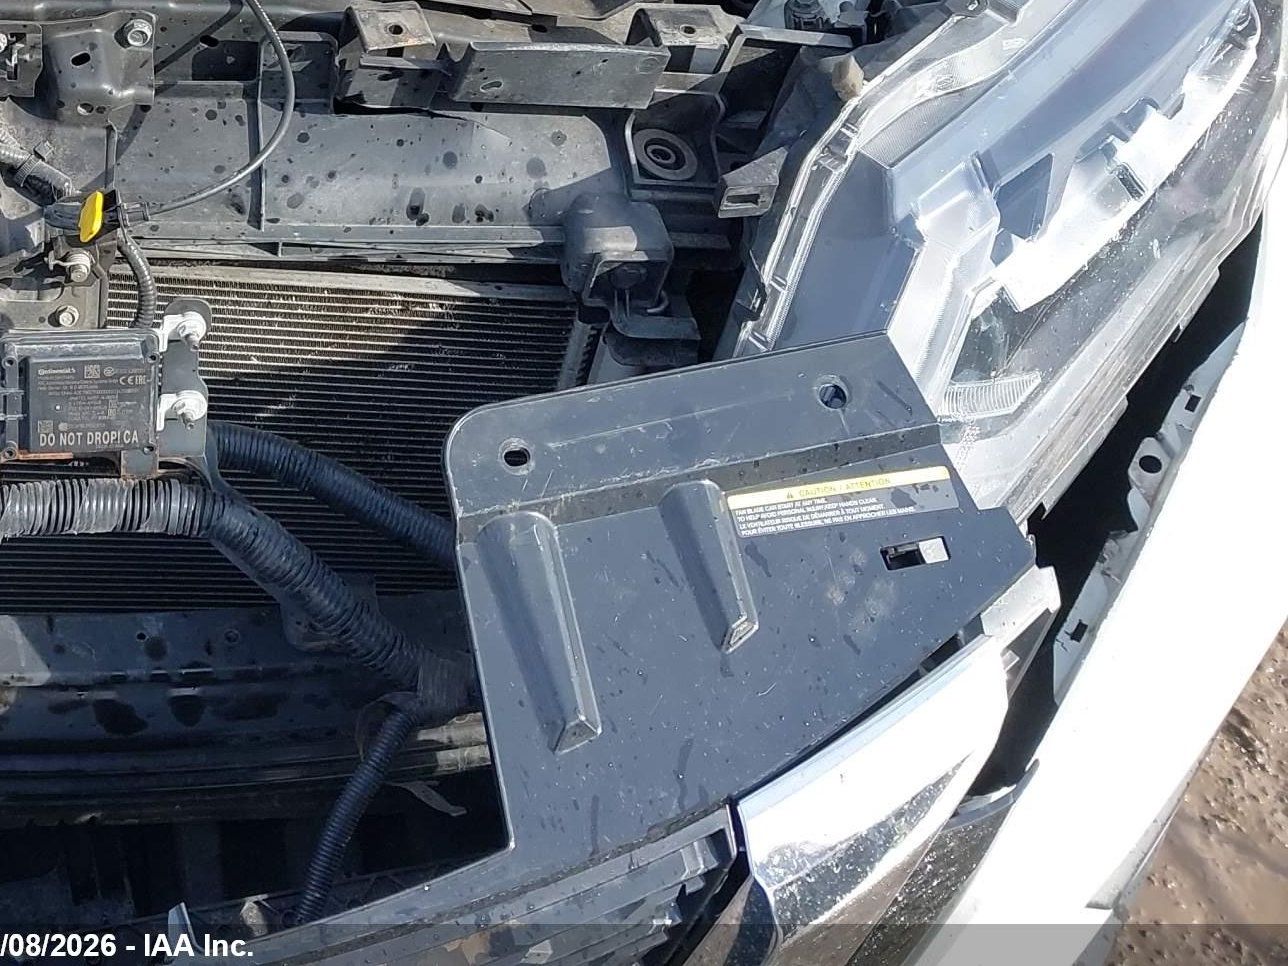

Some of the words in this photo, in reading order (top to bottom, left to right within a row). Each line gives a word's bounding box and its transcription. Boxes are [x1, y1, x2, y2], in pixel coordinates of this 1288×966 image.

[38, 367, 71, 376] Continental
[40, 434, 56, 446] DO
[60, 432, 82, 446] NOT
[800, 486, 836, 497] CAUTION
[846, 478, 891, 491] ATTENTION
